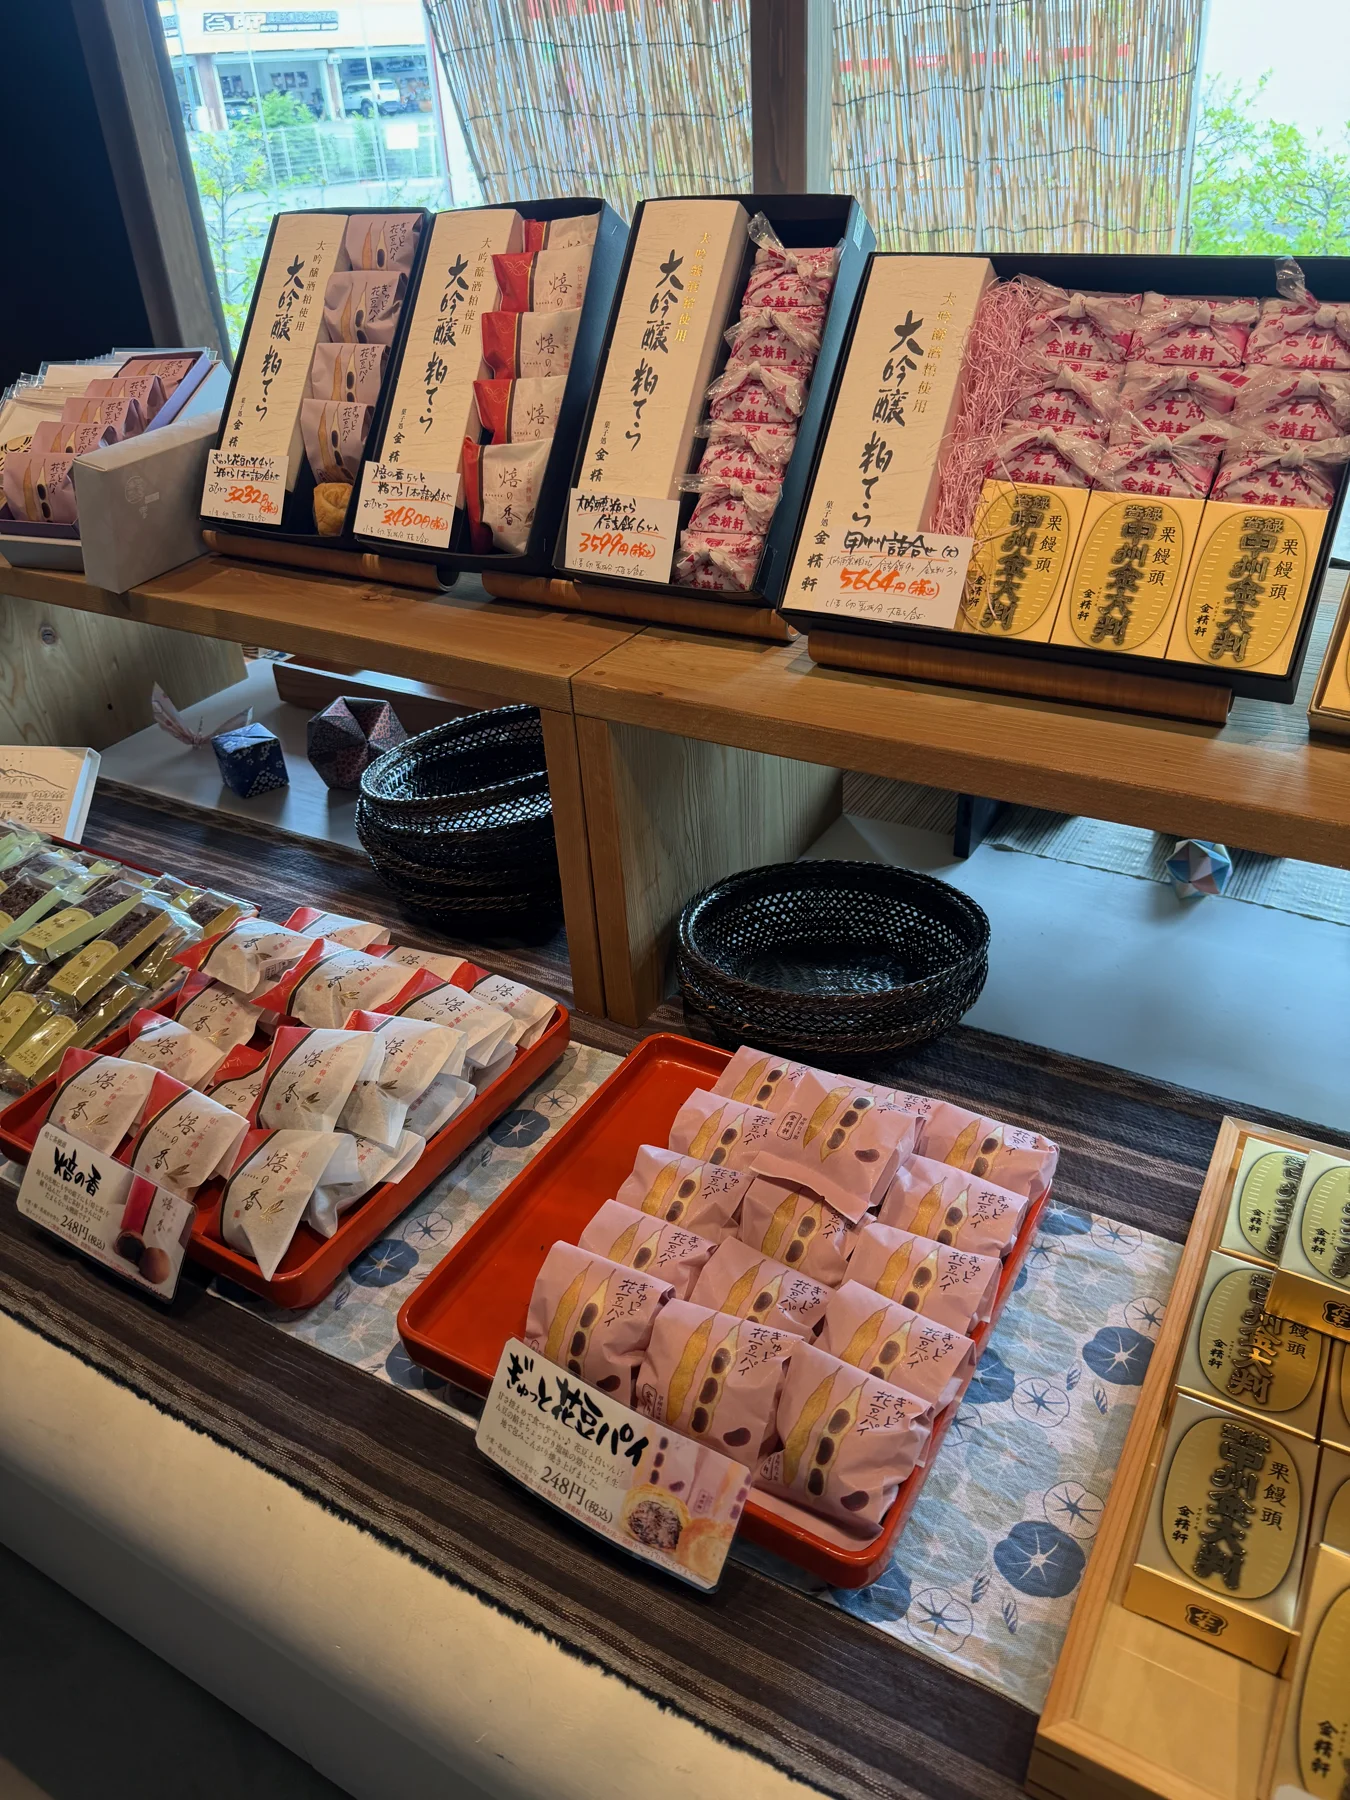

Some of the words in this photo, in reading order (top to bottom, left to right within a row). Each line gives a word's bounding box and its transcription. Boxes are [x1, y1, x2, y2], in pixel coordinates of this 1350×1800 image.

[749, 343, 787, 361] 金精軒
[1046, 338, 1093, 358] 金精軒
[1163, 343, 1215, 362] 金精軒
[732, 408, 769, 422] 金精軒
[1029, 403, 1077, 425] 金精軒
[1142, 417, 1191, 434] 金精軒
[1009, 467, 1057, 486] 金精軒
[1121, 476, 1173, 497] 金精軒
[708, 512, 744, 532] 金精軒
[1034, 515, 1062, 573] 栗饅頭
[1147, 527, 1176, 587] 栗饅頭
[1268, 538, 1298, 601] 栗饅頭
[969, 575, 986, 607] 金精軒
[1077, 588, 1096, 621] 金精軒
[1194, 603, 1214, 637] 金精軒
[281, 1049, 324, 1103] 焙の香
[69, 1070, 117, 1121] 焙の香
[152, 1111, 199, 1170] 焙の香
[53, 1146, 102, 1197] 焙の香
[242, 1149, 289, 1211] 焙の香
[1247, 1208, 1266, 1234] 金精軒
[1311, 1227, 1330, 1255] 金精軒
[1207, 1338, 1228, 1369] 金精軒
[506, 1352, 650, 1468] ぎゅっと花豆パイ
[1259, 1460, 1291, 1531] 栗饅頭
[1172, 1505, 1194, 1544] 金精軒
